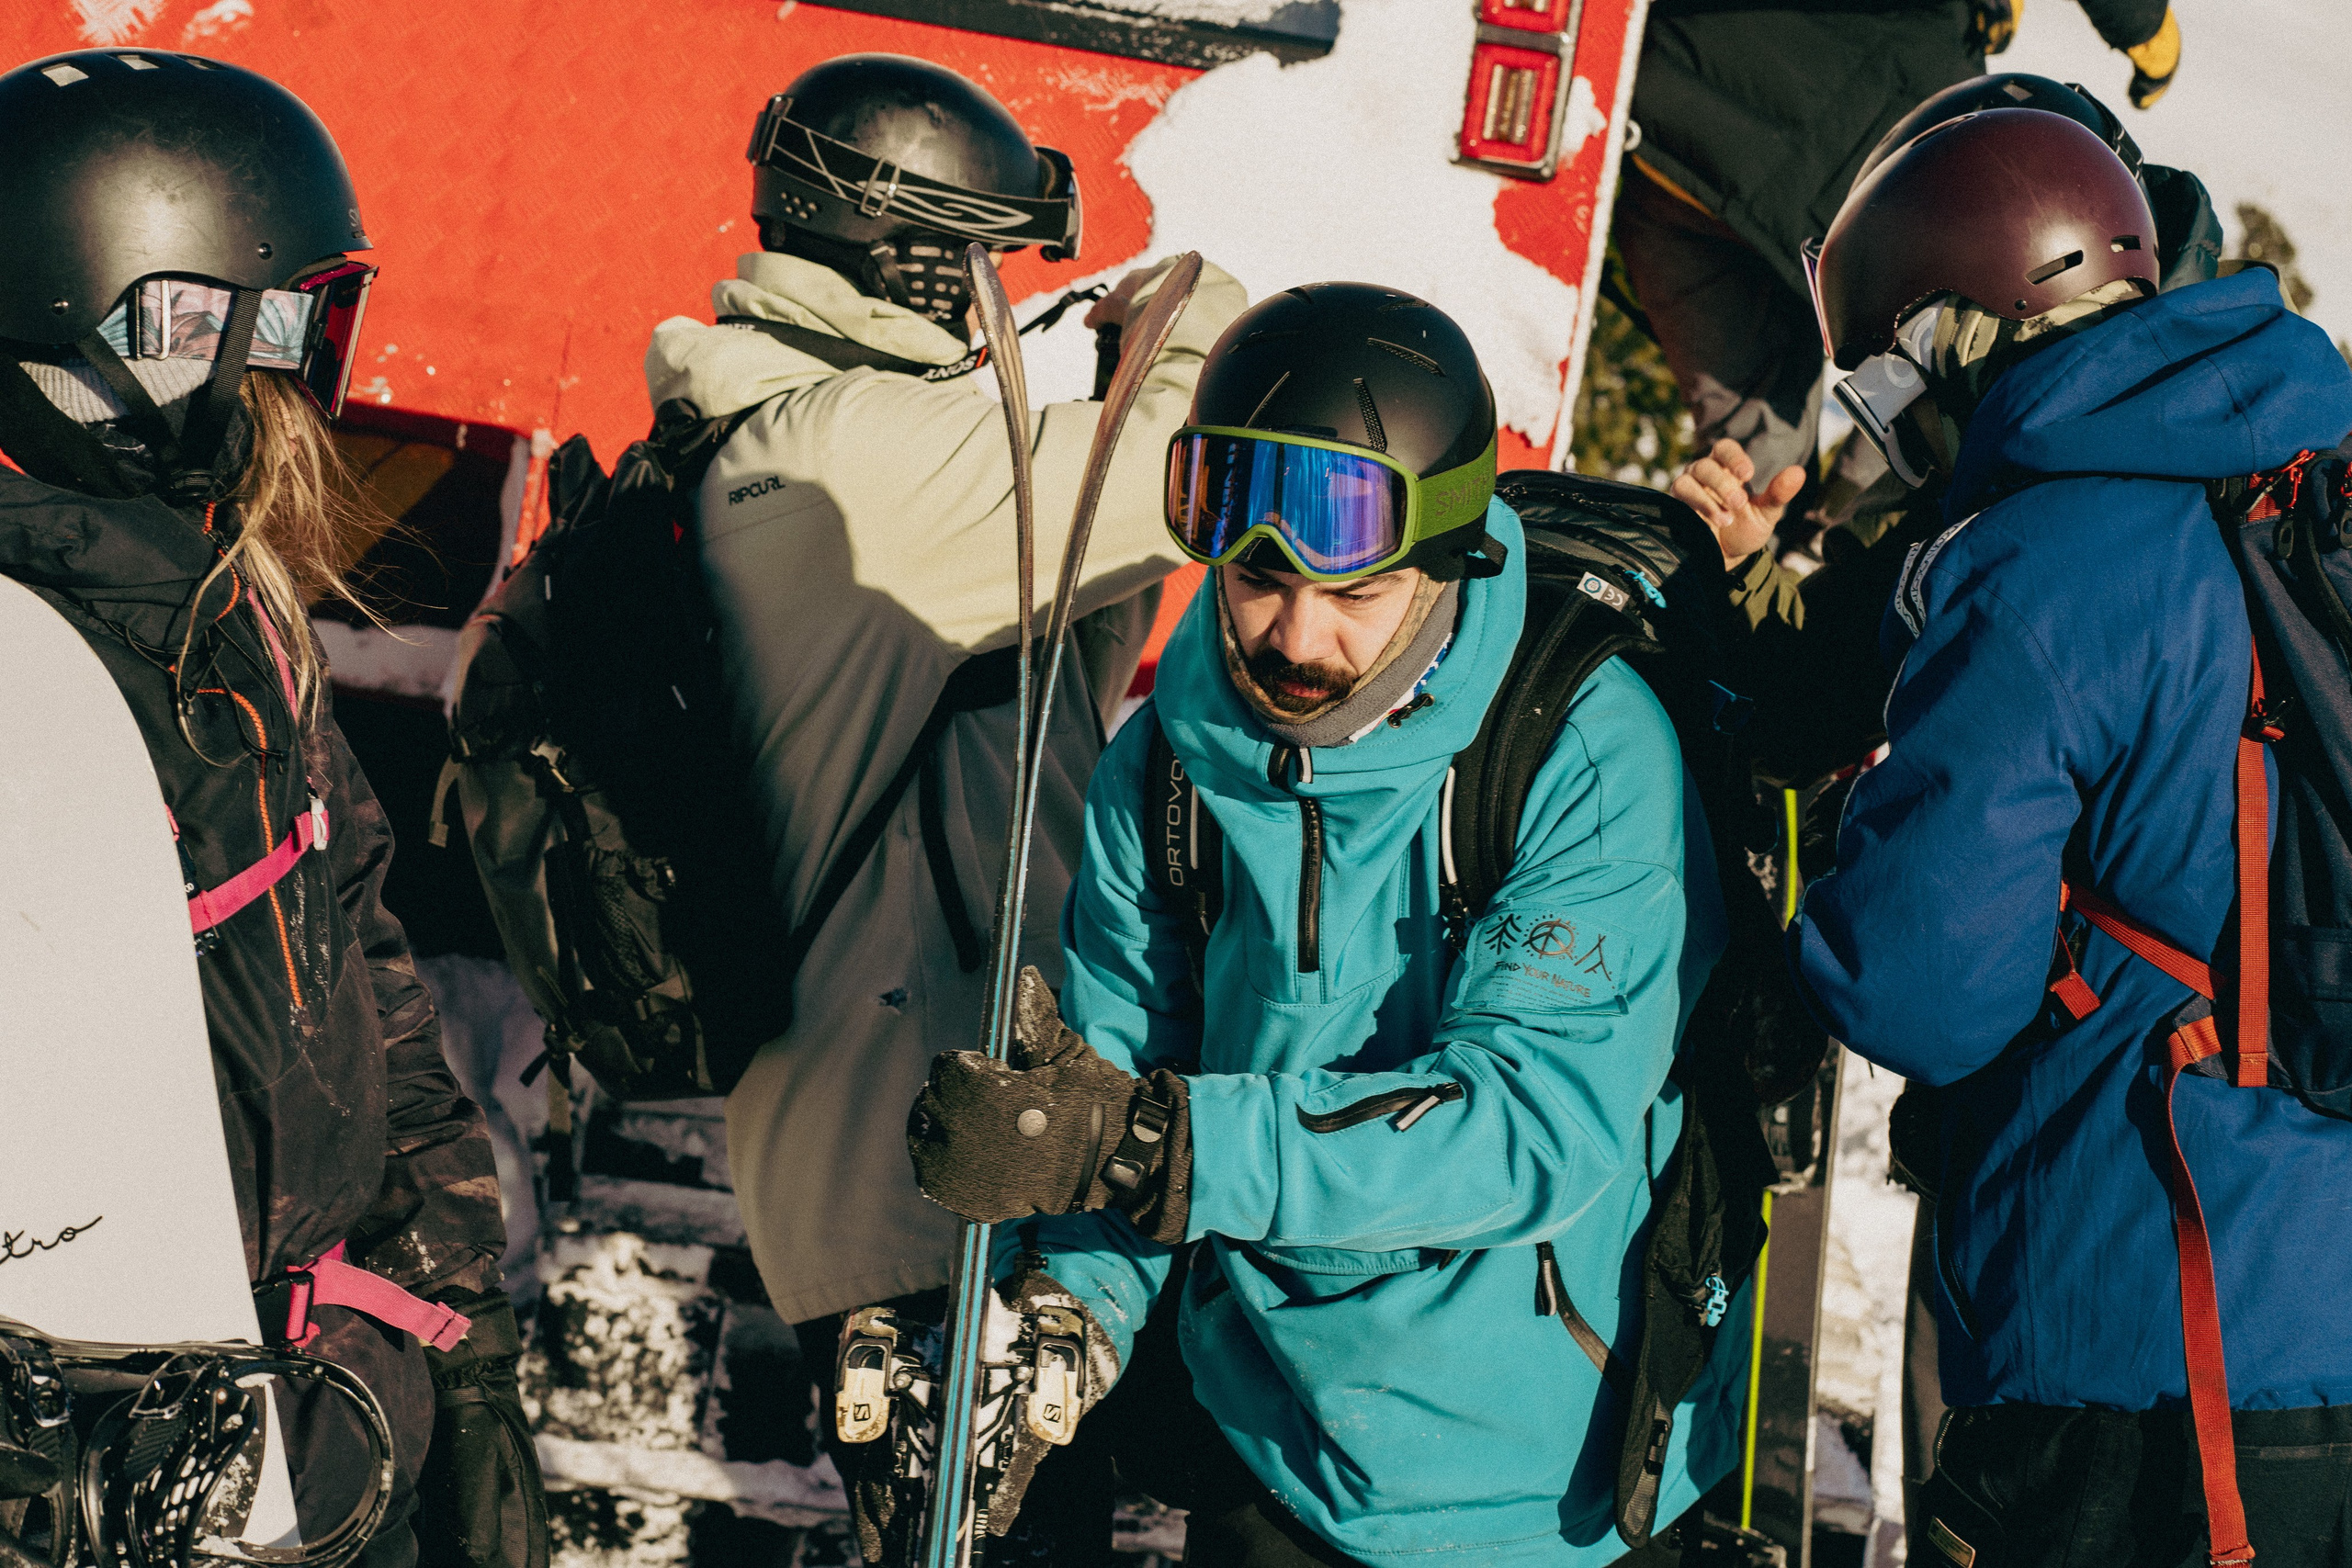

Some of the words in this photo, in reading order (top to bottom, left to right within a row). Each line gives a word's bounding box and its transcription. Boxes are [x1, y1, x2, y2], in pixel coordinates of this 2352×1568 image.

[1167, 753, 1184, 886] ORTOVO
[1522, 963, 1550, 981] YOUR
[1551, 974, 1591, 998] NATURE
